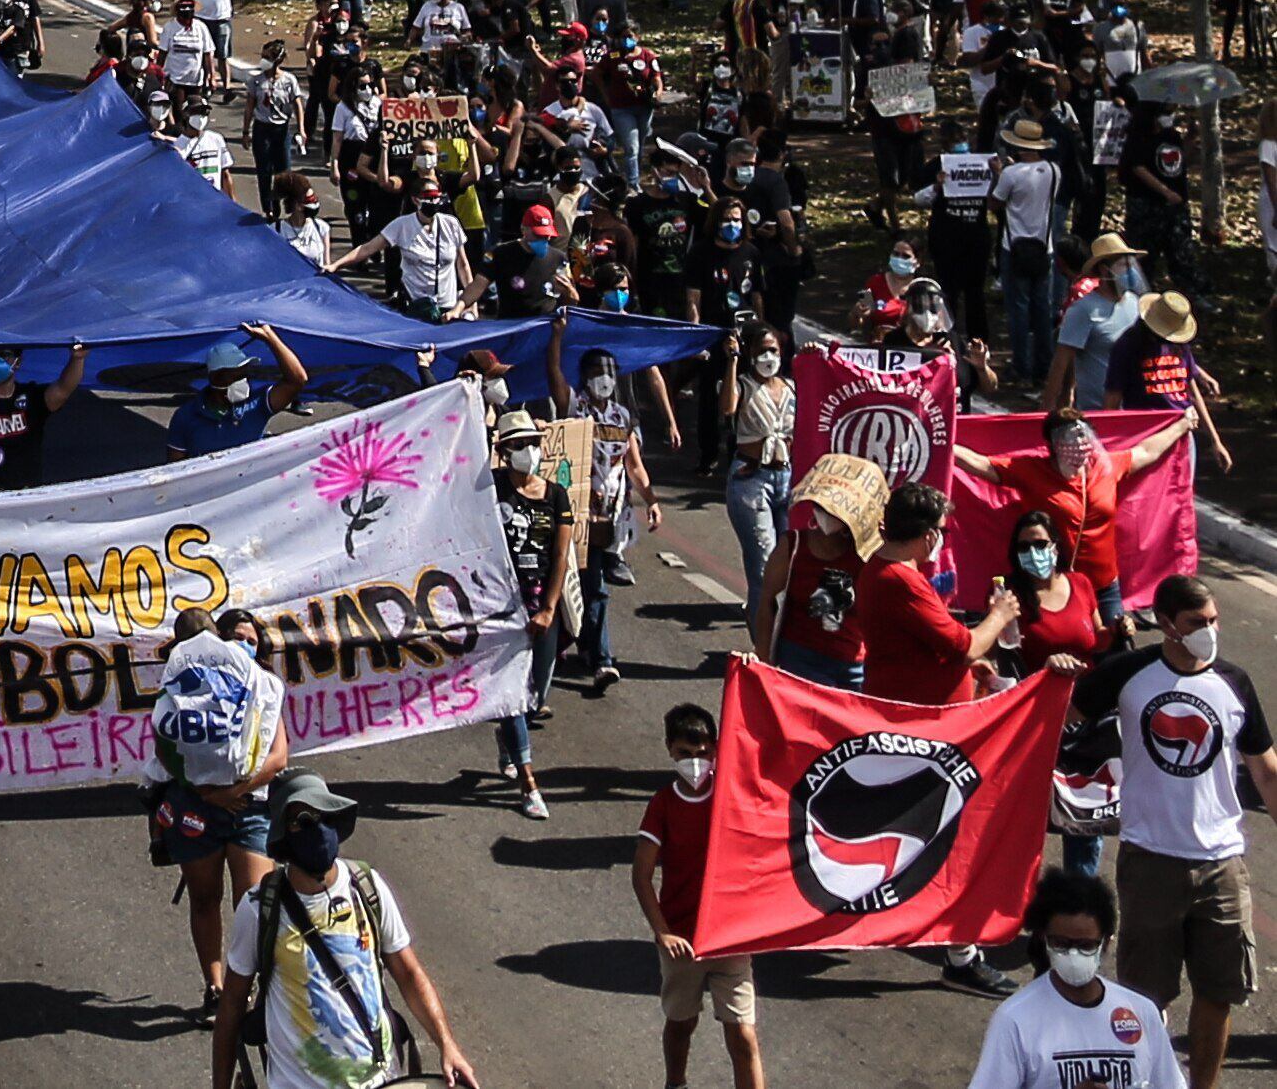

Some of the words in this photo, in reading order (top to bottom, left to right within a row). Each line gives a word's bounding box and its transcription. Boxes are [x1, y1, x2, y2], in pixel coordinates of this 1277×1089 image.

[383, 99, 432, 120] FORA
[384, 118, 469, 141] BOLSONARO
[949, 168, 992, 182] VACINA
[818, 393, 839, 432] UNIÃO
[920, 391, 947, 446] MULHERES
[541, 426, 566, 457] RA
[283, 666, 483, 761] ULHERES
[1161, 763, 1201, 778] AKTION
